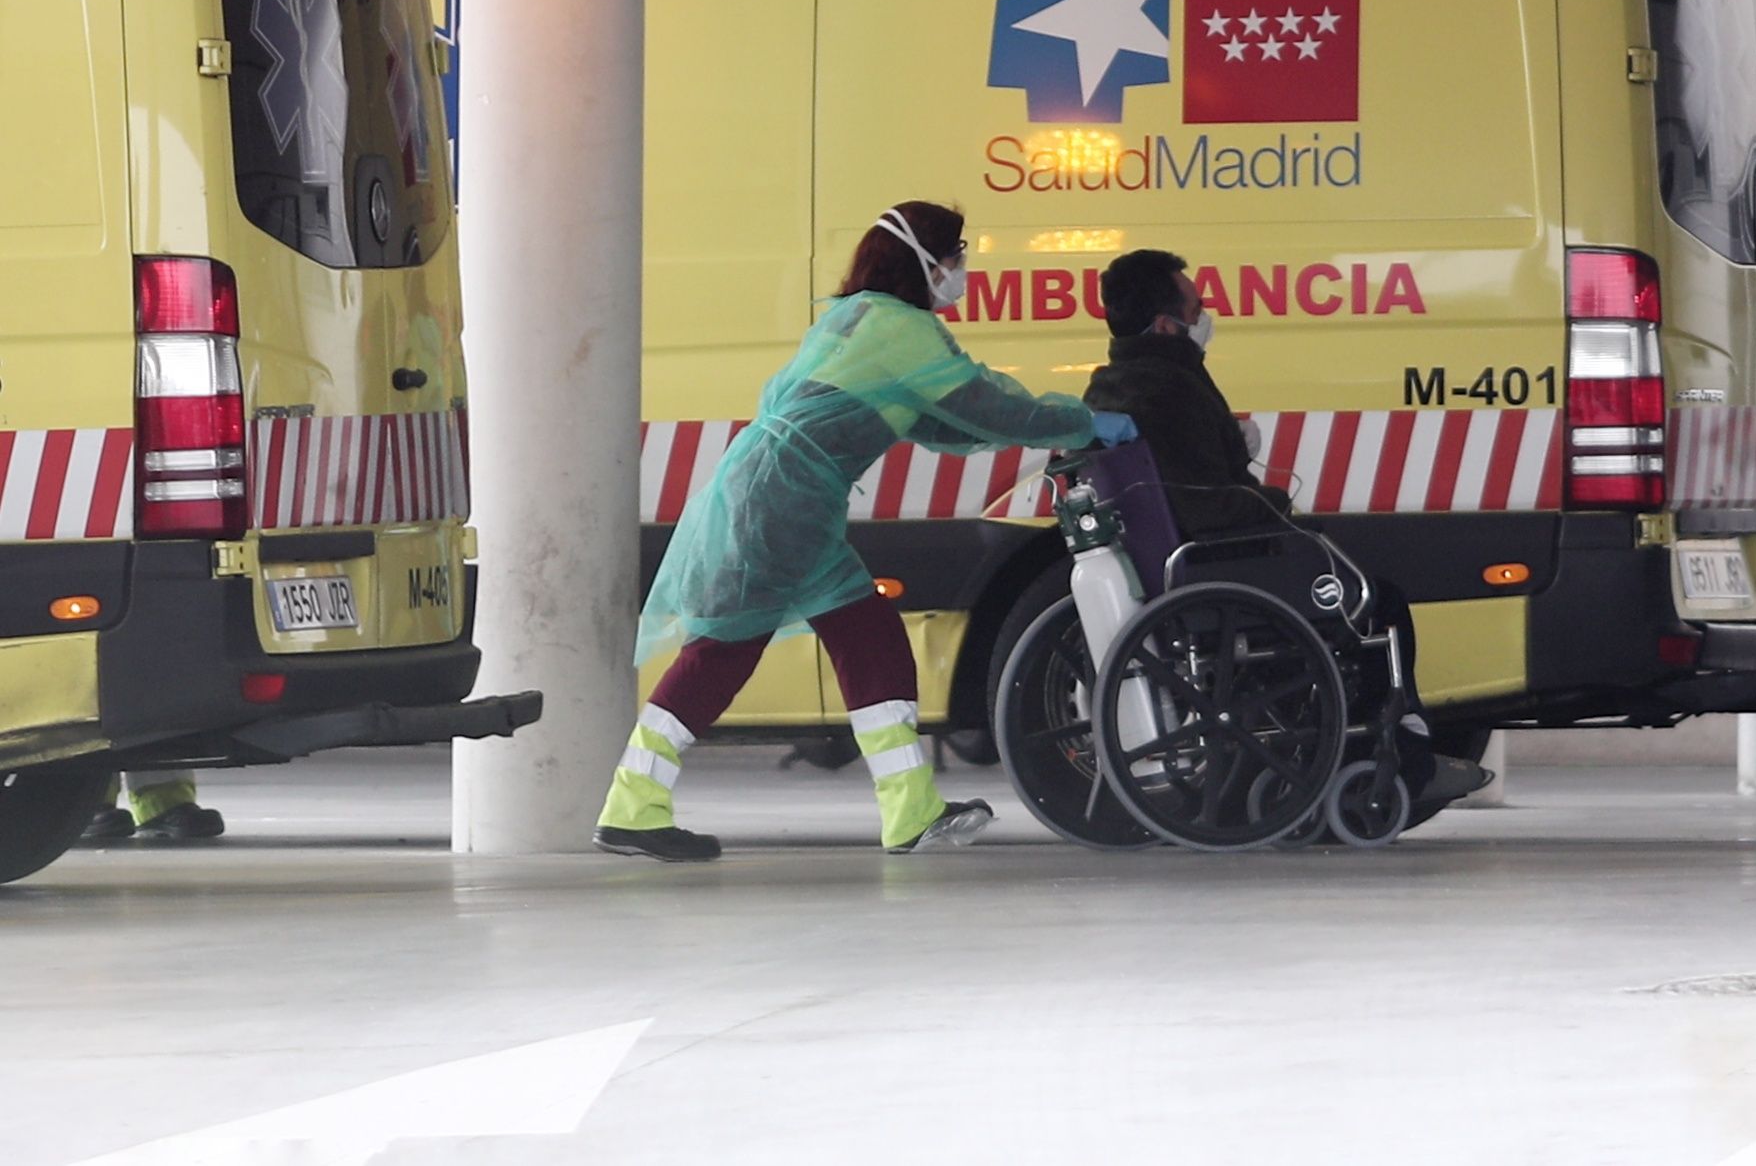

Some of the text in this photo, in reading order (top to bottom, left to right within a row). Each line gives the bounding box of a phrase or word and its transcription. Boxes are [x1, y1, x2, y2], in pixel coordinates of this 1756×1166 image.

[983, 132, 1361, 193] SaludMadrid
[934, 263, 1427, 323] MBUANCIA
[1403, 365, 1559, 407] M-401
[282, 582, 355, 624] 1550 JZR
